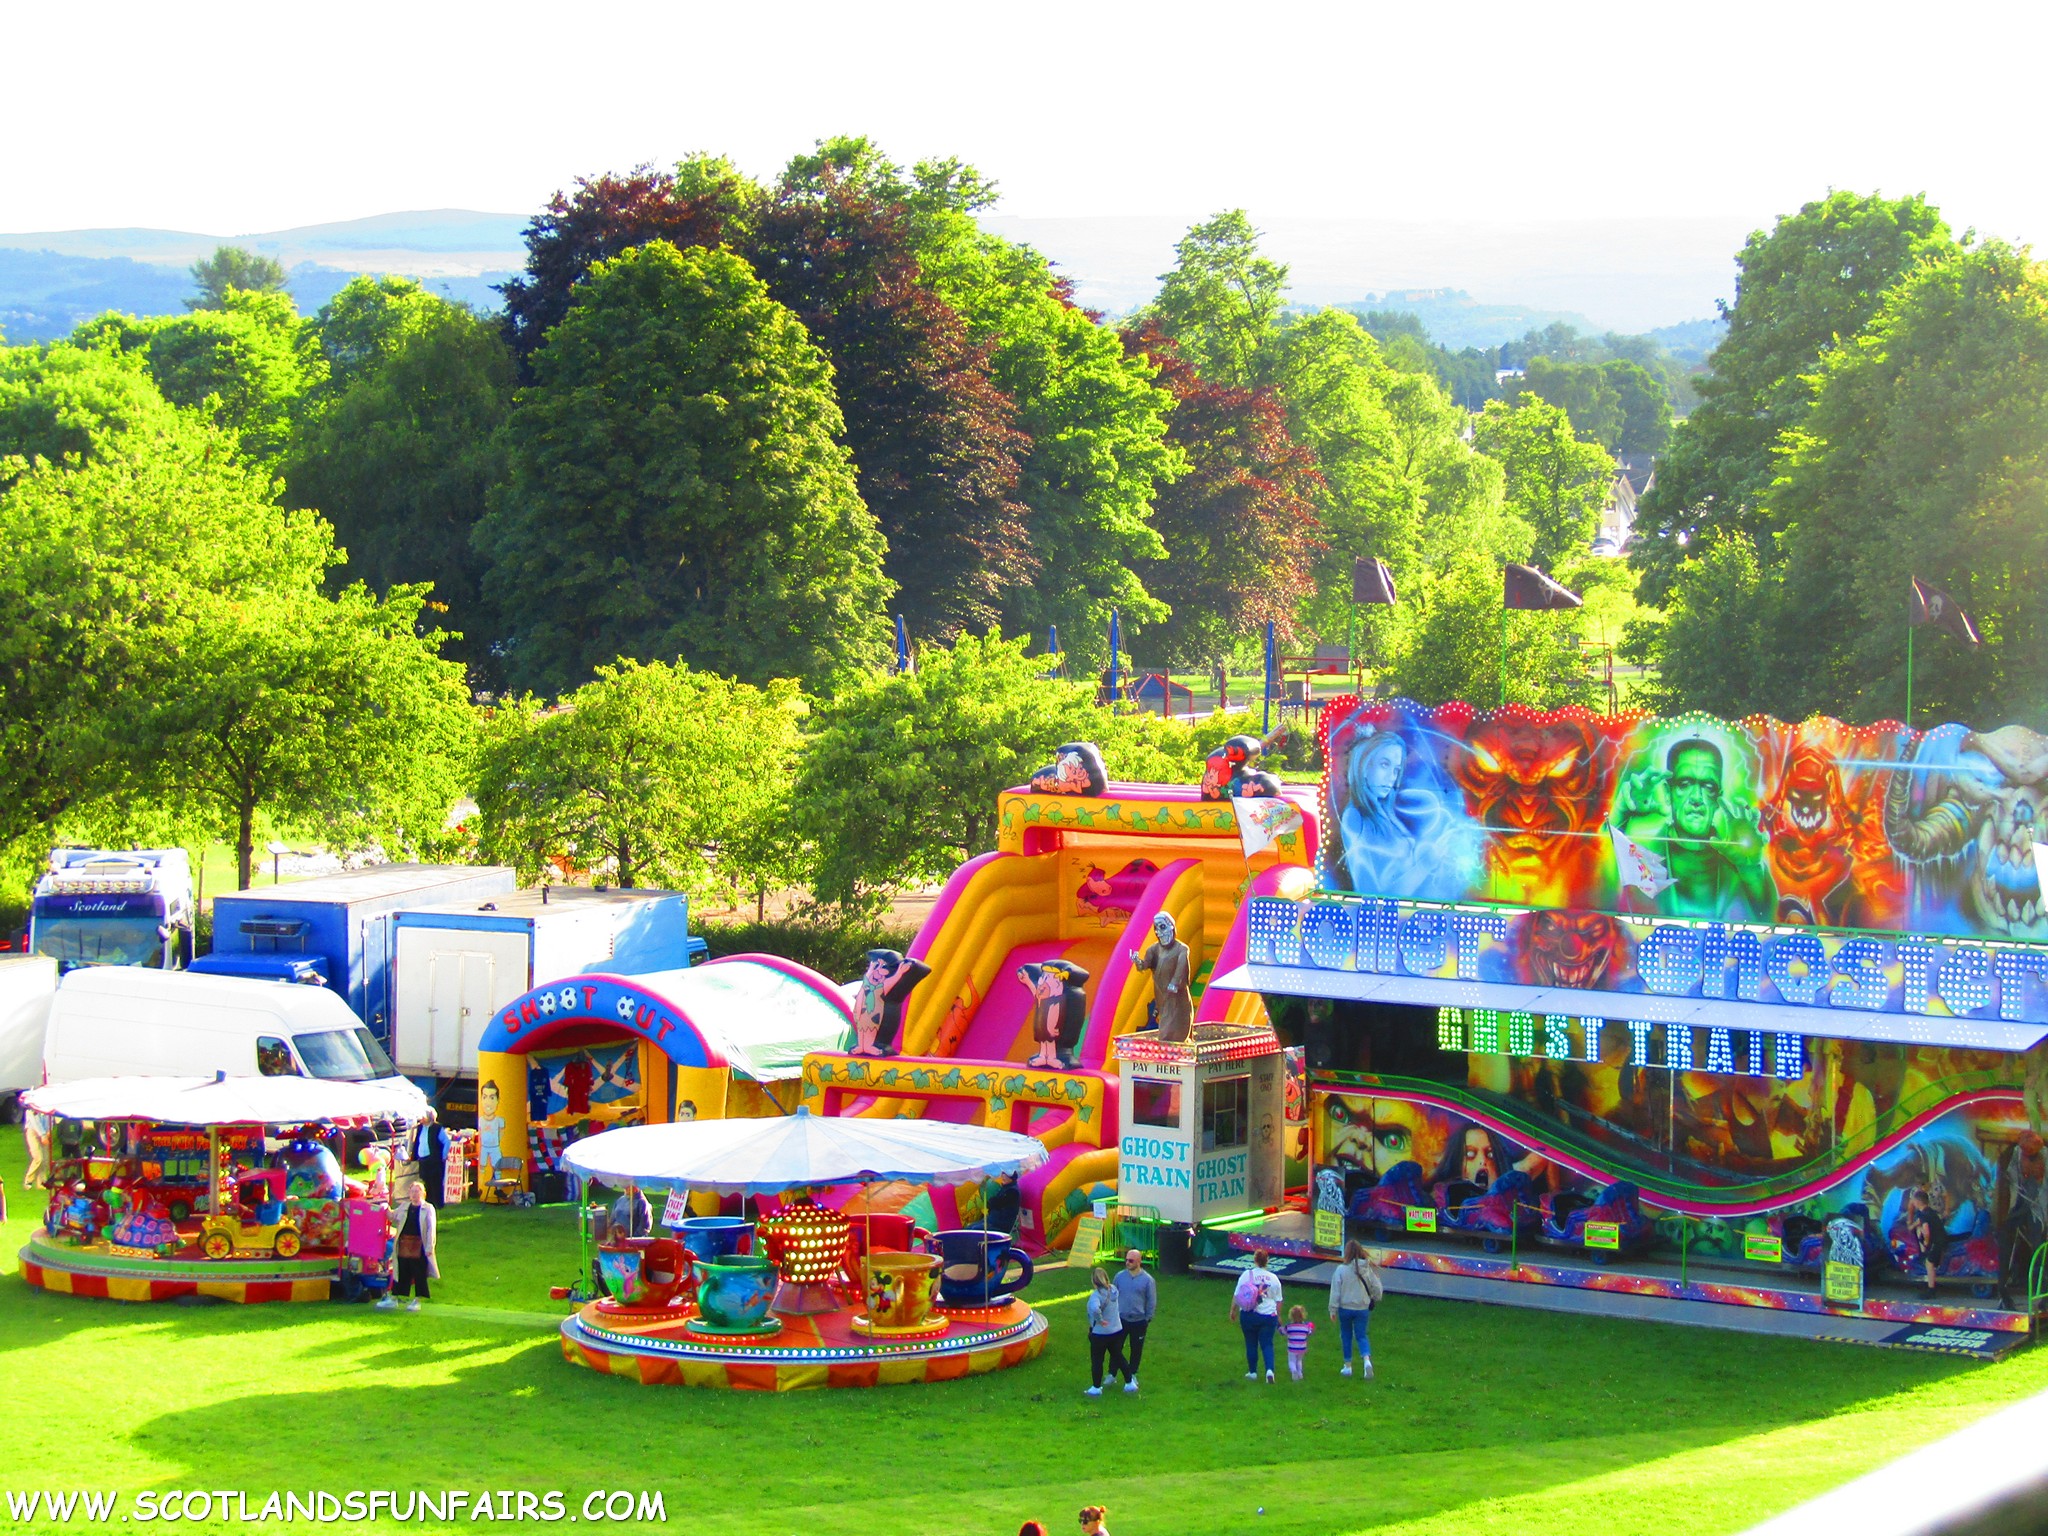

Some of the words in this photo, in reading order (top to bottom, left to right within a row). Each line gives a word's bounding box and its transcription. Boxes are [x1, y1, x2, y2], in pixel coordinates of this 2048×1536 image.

[69, 900, 128, 912] Scotland
[1437, 1005, 1604, 1063] GHOST
[1628, 1019, 1803, 1081] TRAIN
[1132, 1062, 1150, 1072] PAY
[1156, 1064, 1182, 1075] HERE
[1208, 1062, 1222, 1074] PAY
[1225, 1060, 1246, 1072] HERE
[1121, 1136, 1190, 1162] GHOST
[1196, 1153, 1247, 1180] GHOST
[1121, 1163, 1191, 1190] TRAIN
[446, 1186, 461, 1197] TIME
[1197, 1177, 1245, 1203] TRAIN
[667, 1199, 684, 1210] EVERY
[664, 1209, 681, 1221] TIME
